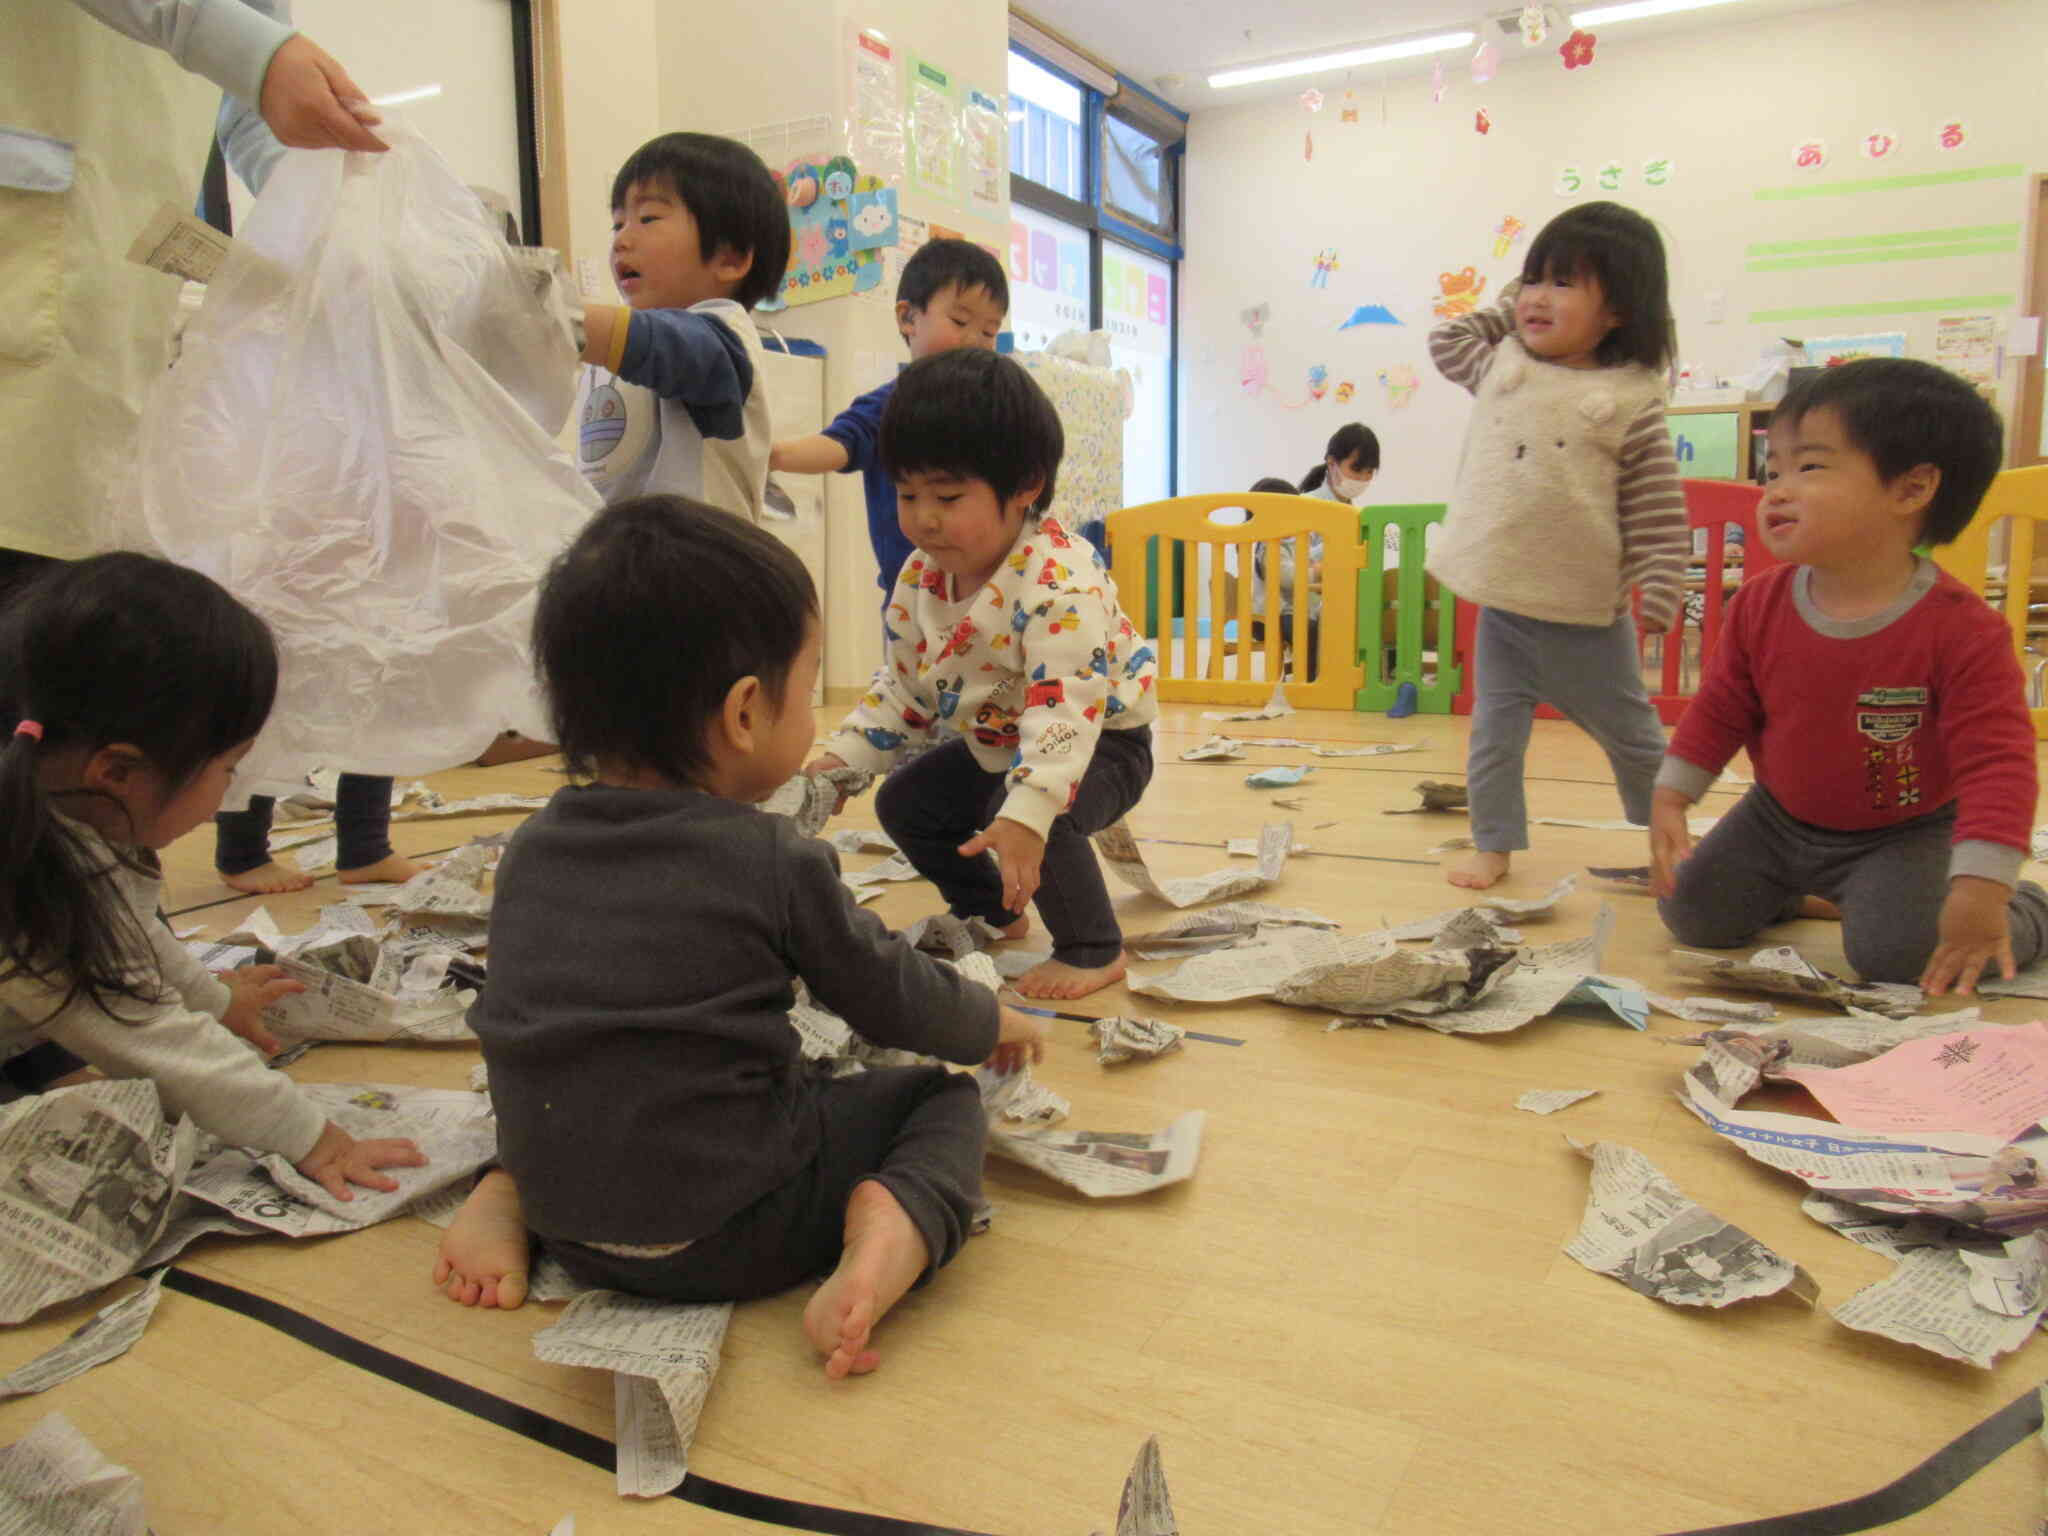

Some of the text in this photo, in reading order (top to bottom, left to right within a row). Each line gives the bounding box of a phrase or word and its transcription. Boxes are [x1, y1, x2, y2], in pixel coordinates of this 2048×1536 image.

[1796, 122, 1964, 168] あひる
[1561, 160, 1669, 192] うさぎ
